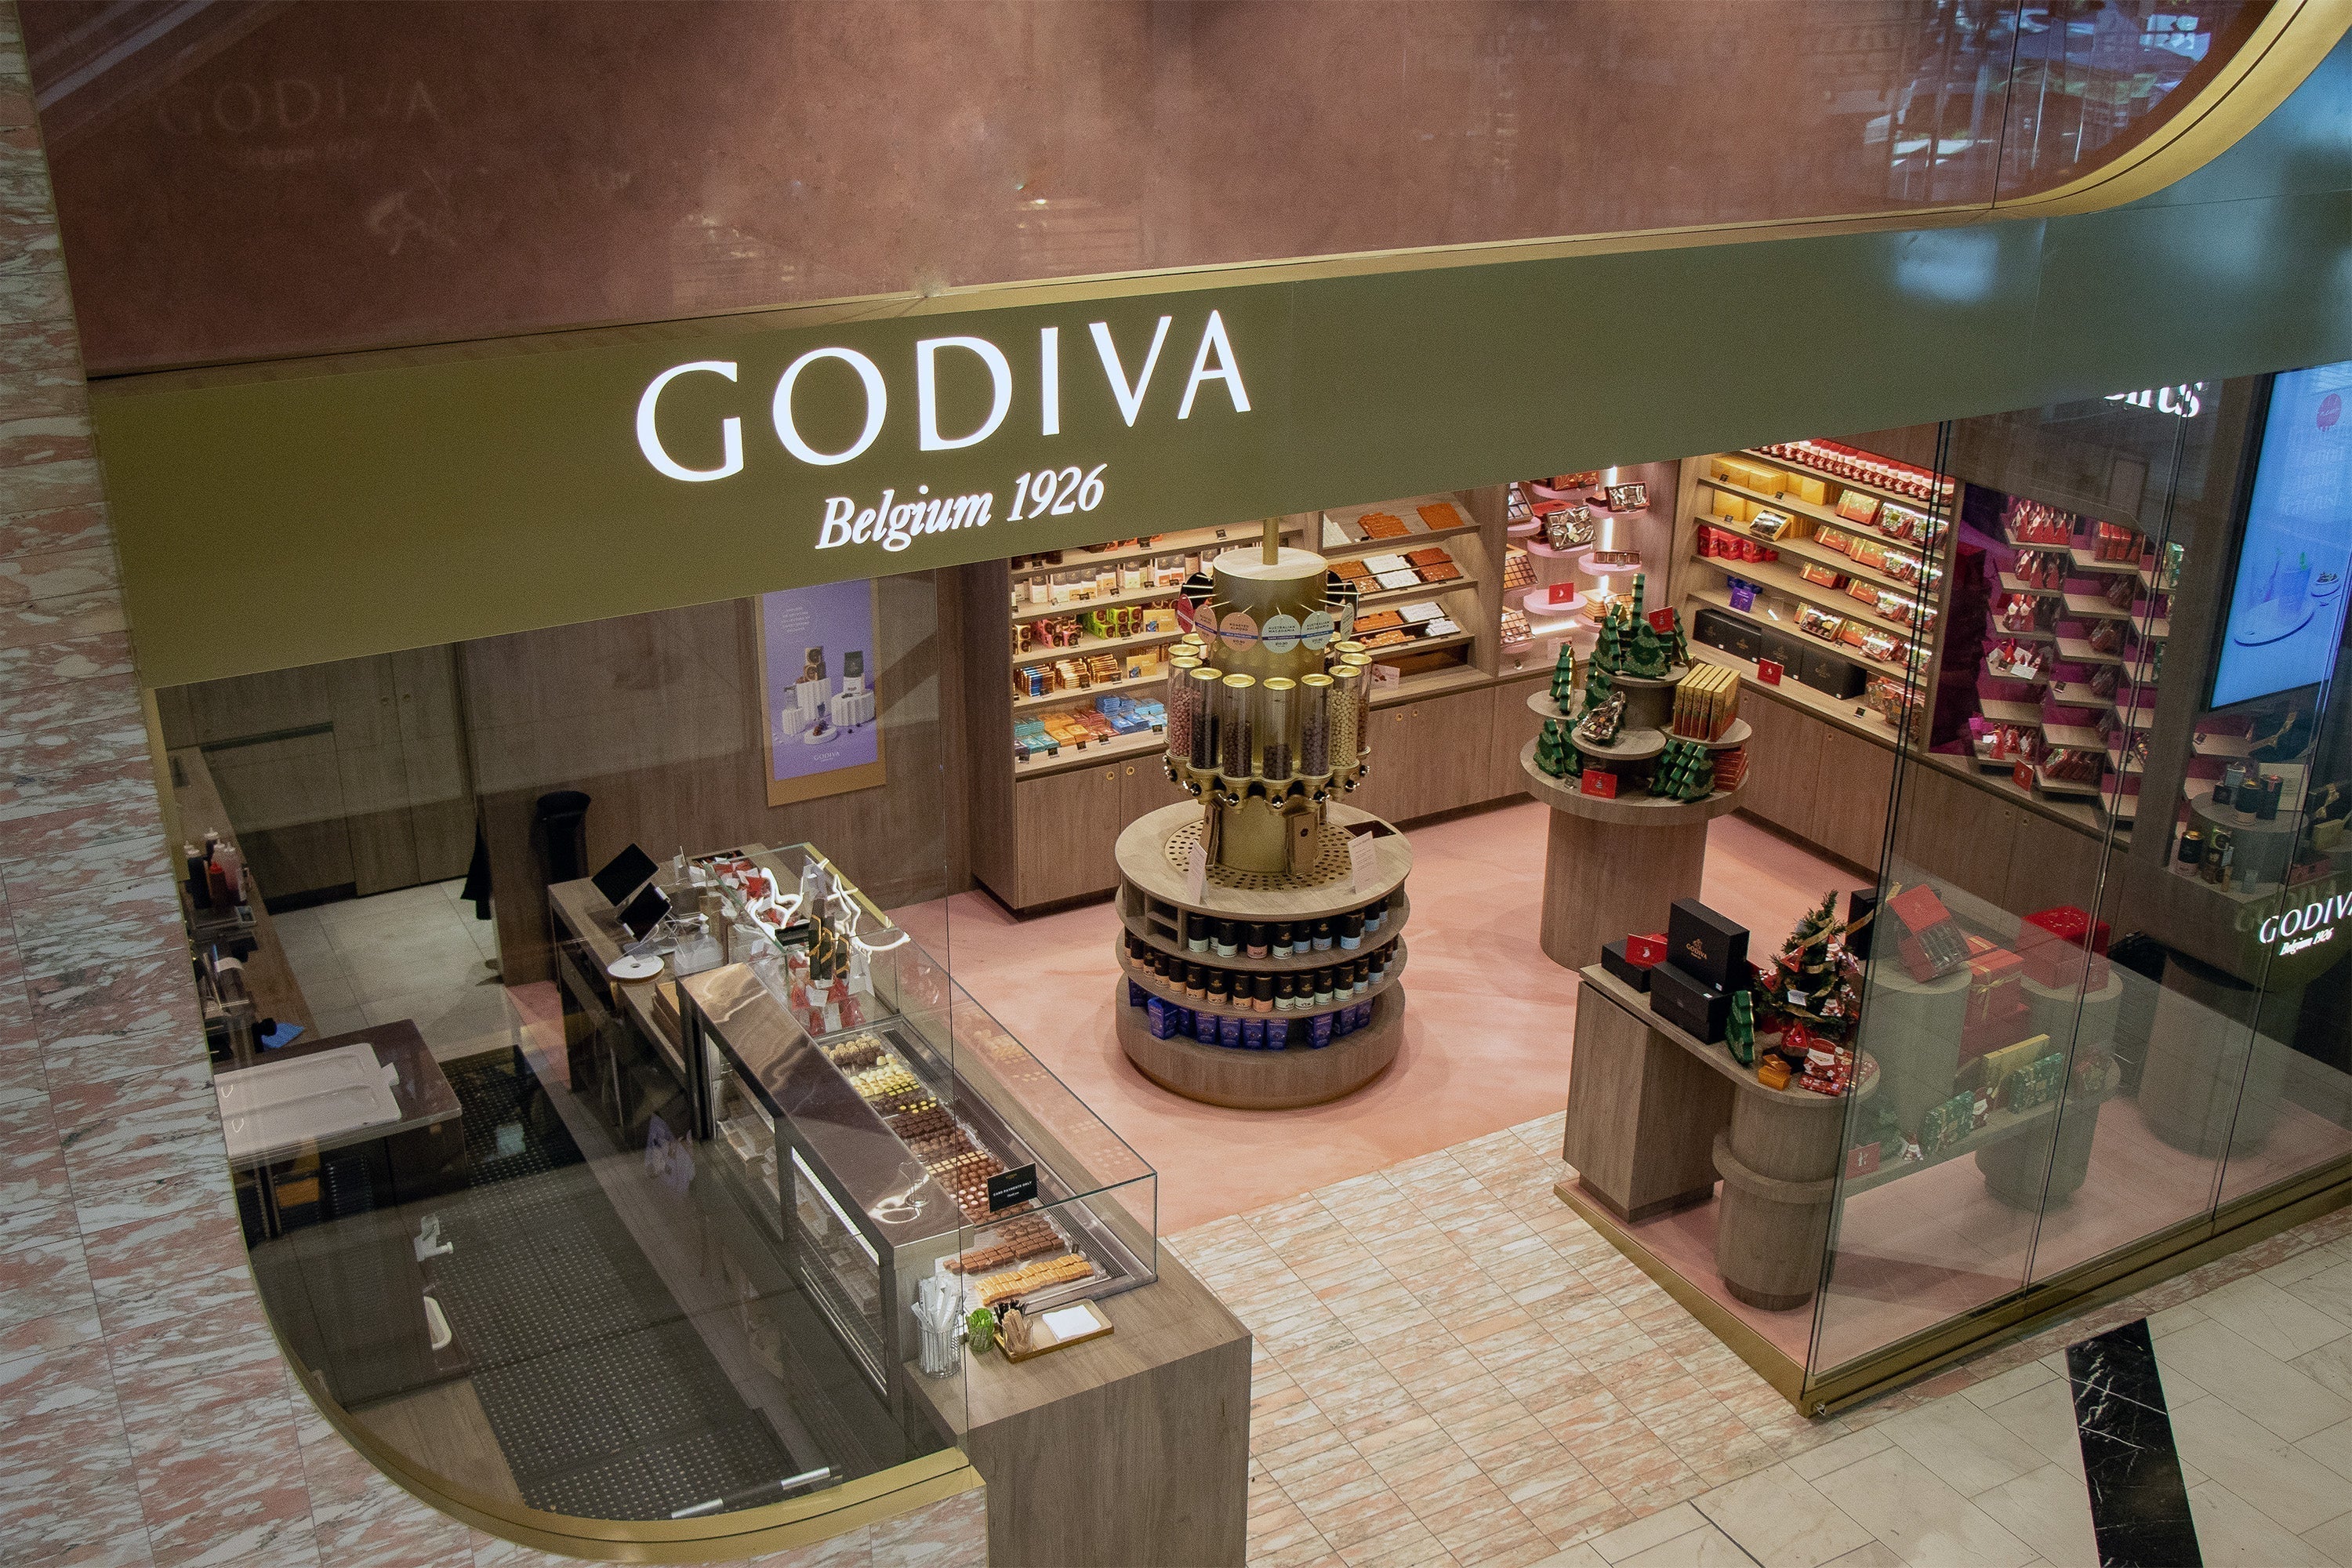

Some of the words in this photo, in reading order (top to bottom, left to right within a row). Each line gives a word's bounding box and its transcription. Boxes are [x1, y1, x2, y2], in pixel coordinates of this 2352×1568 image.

[636, 309, 1252, 482] GODIVA
[815, 484, 993, 553] Belgium
[1007, 463, 1109, 521] 1926
[1004, 1184, 1022, 1193] PAYMENTS
